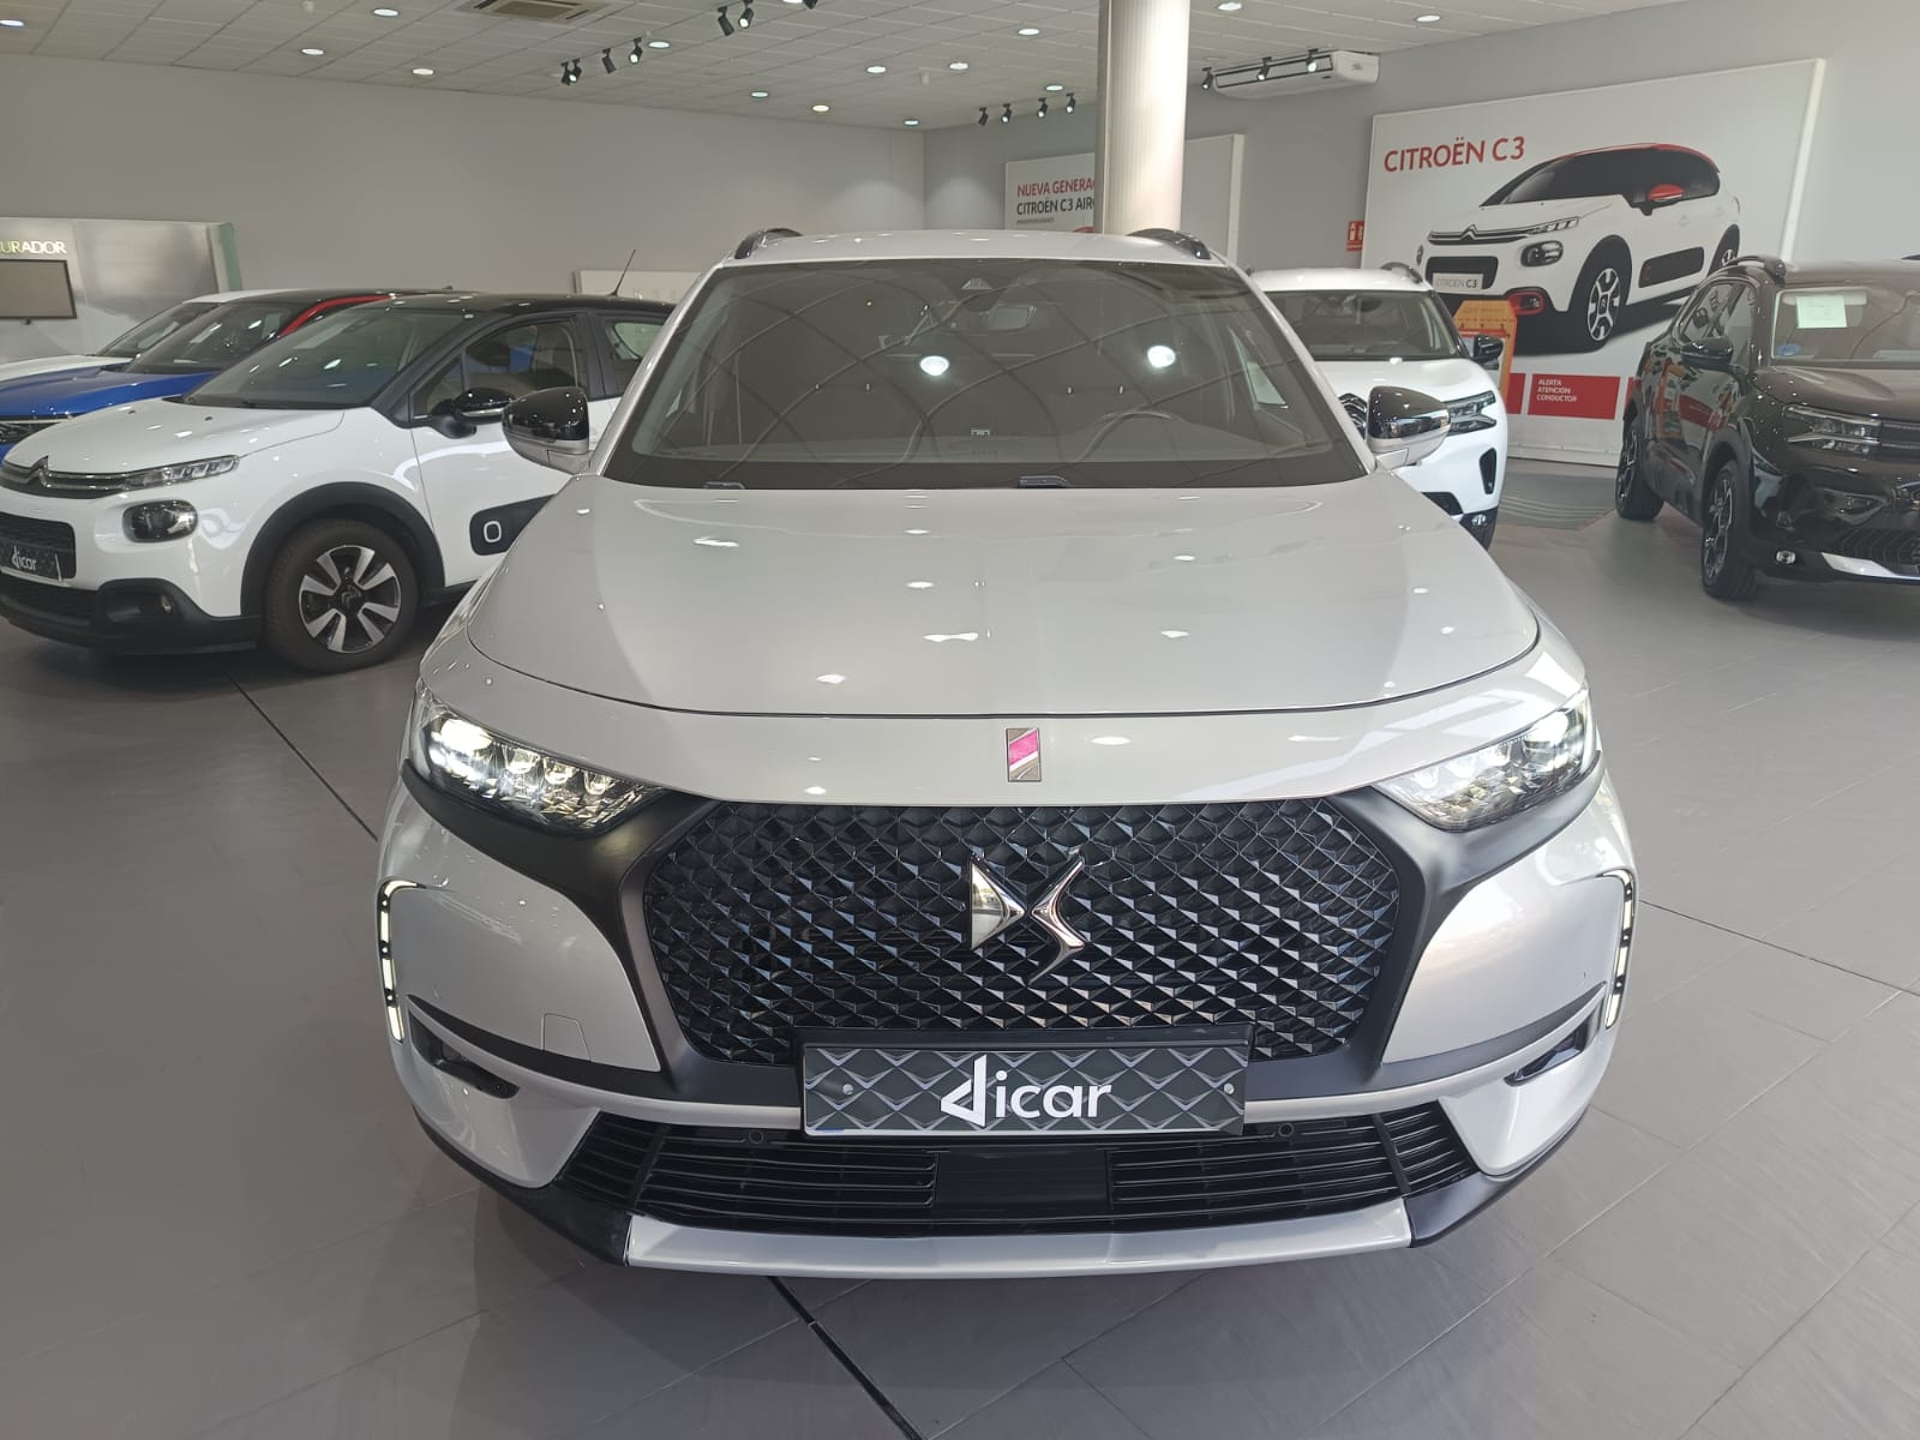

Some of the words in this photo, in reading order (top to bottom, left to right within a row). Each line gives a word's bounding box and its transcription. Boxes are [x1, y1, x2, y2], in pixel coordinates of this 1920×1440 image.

[1384, 136, 1486, 172] CITROËN
[1492, 135, 1525, 161] C3
[1017, 182, 1051, 197] NUEVA
[1052, 177, 1095, 194] GENERA
[1060, 198, 1074, 212] C3
[1075, 196, 1095, 211] AIR
[1465, 279, 1478, 289] C3
[1536, 394, 1577, 403] CONDUCTOR
[940, 1054, 1112, 1127] dicar
